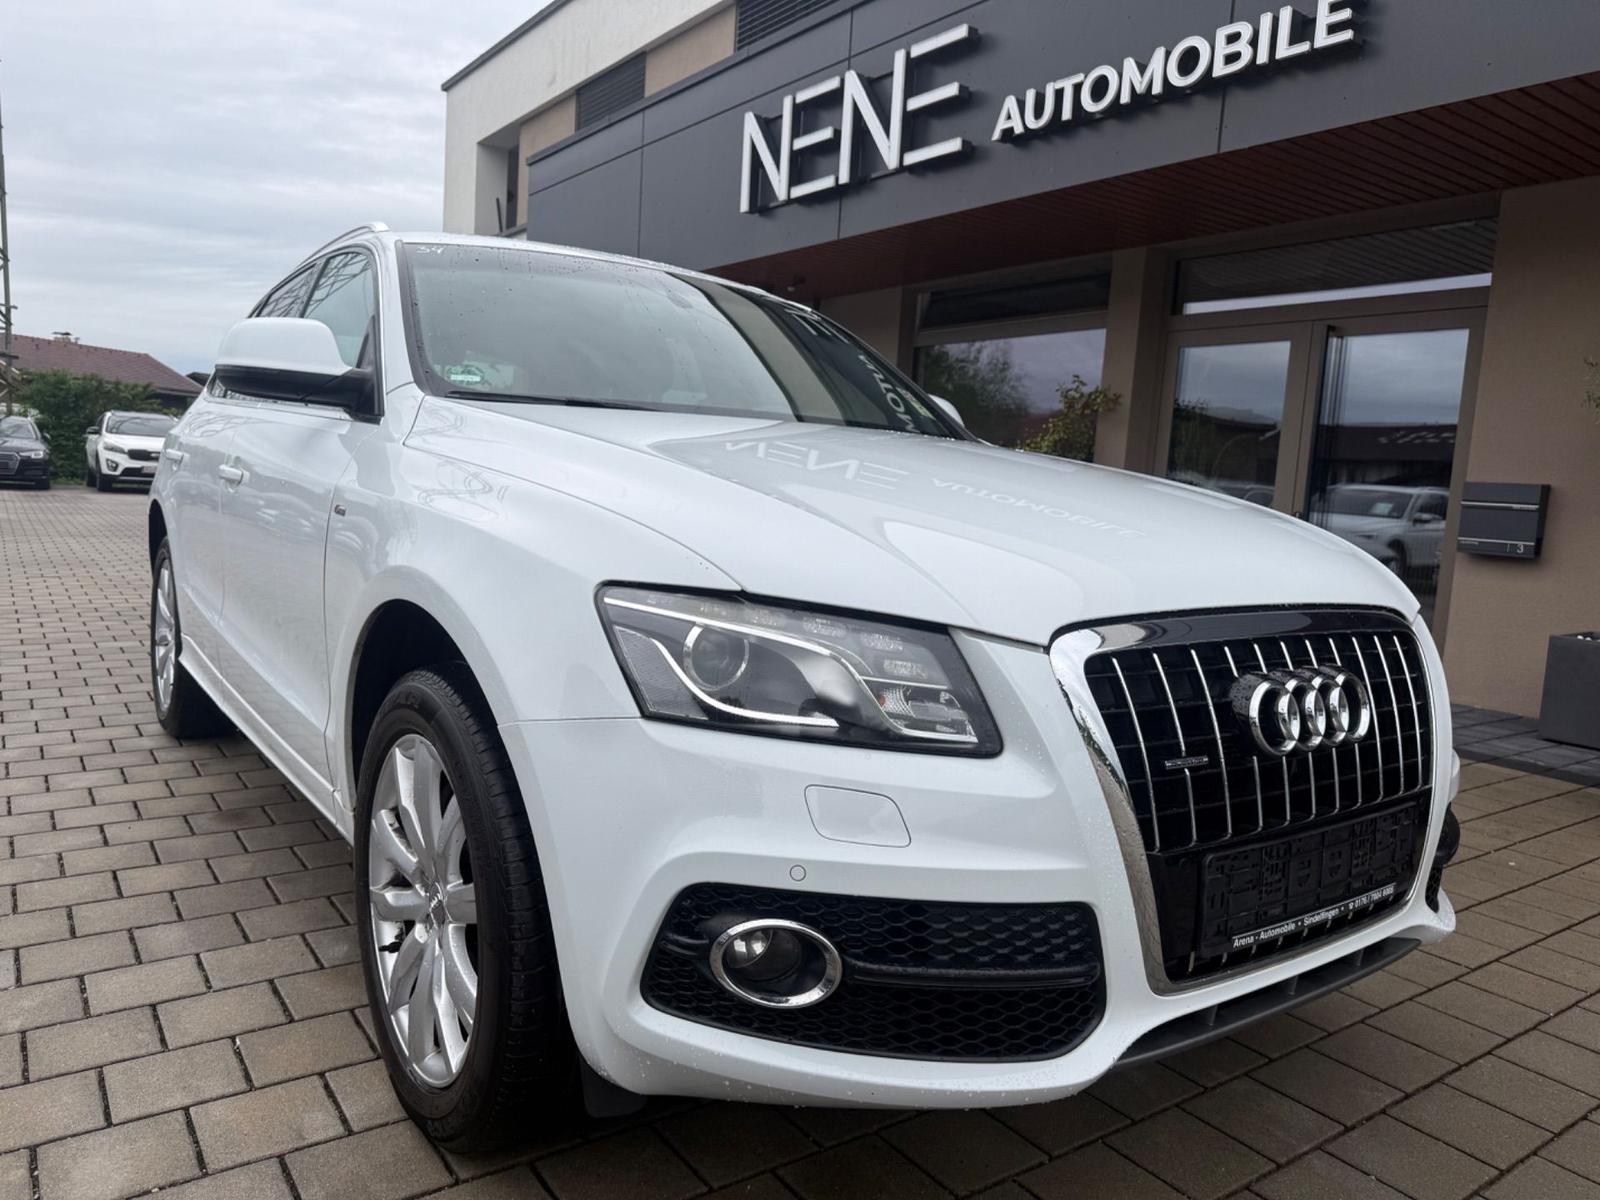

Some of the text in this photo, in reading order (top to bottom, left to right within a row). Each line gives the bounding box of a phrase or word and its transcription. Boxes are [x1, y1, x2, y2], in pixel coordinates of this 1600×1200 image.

[739, 0, 1354, 213] NENE AUTOMOBILE
[1516, 544, 1524, 554] 3
[1233, 936, 1254, 948] Arena
[1260, 922, 1296, 939] Automobile
[1303, 908, 1340, 926] Sindelfingen
